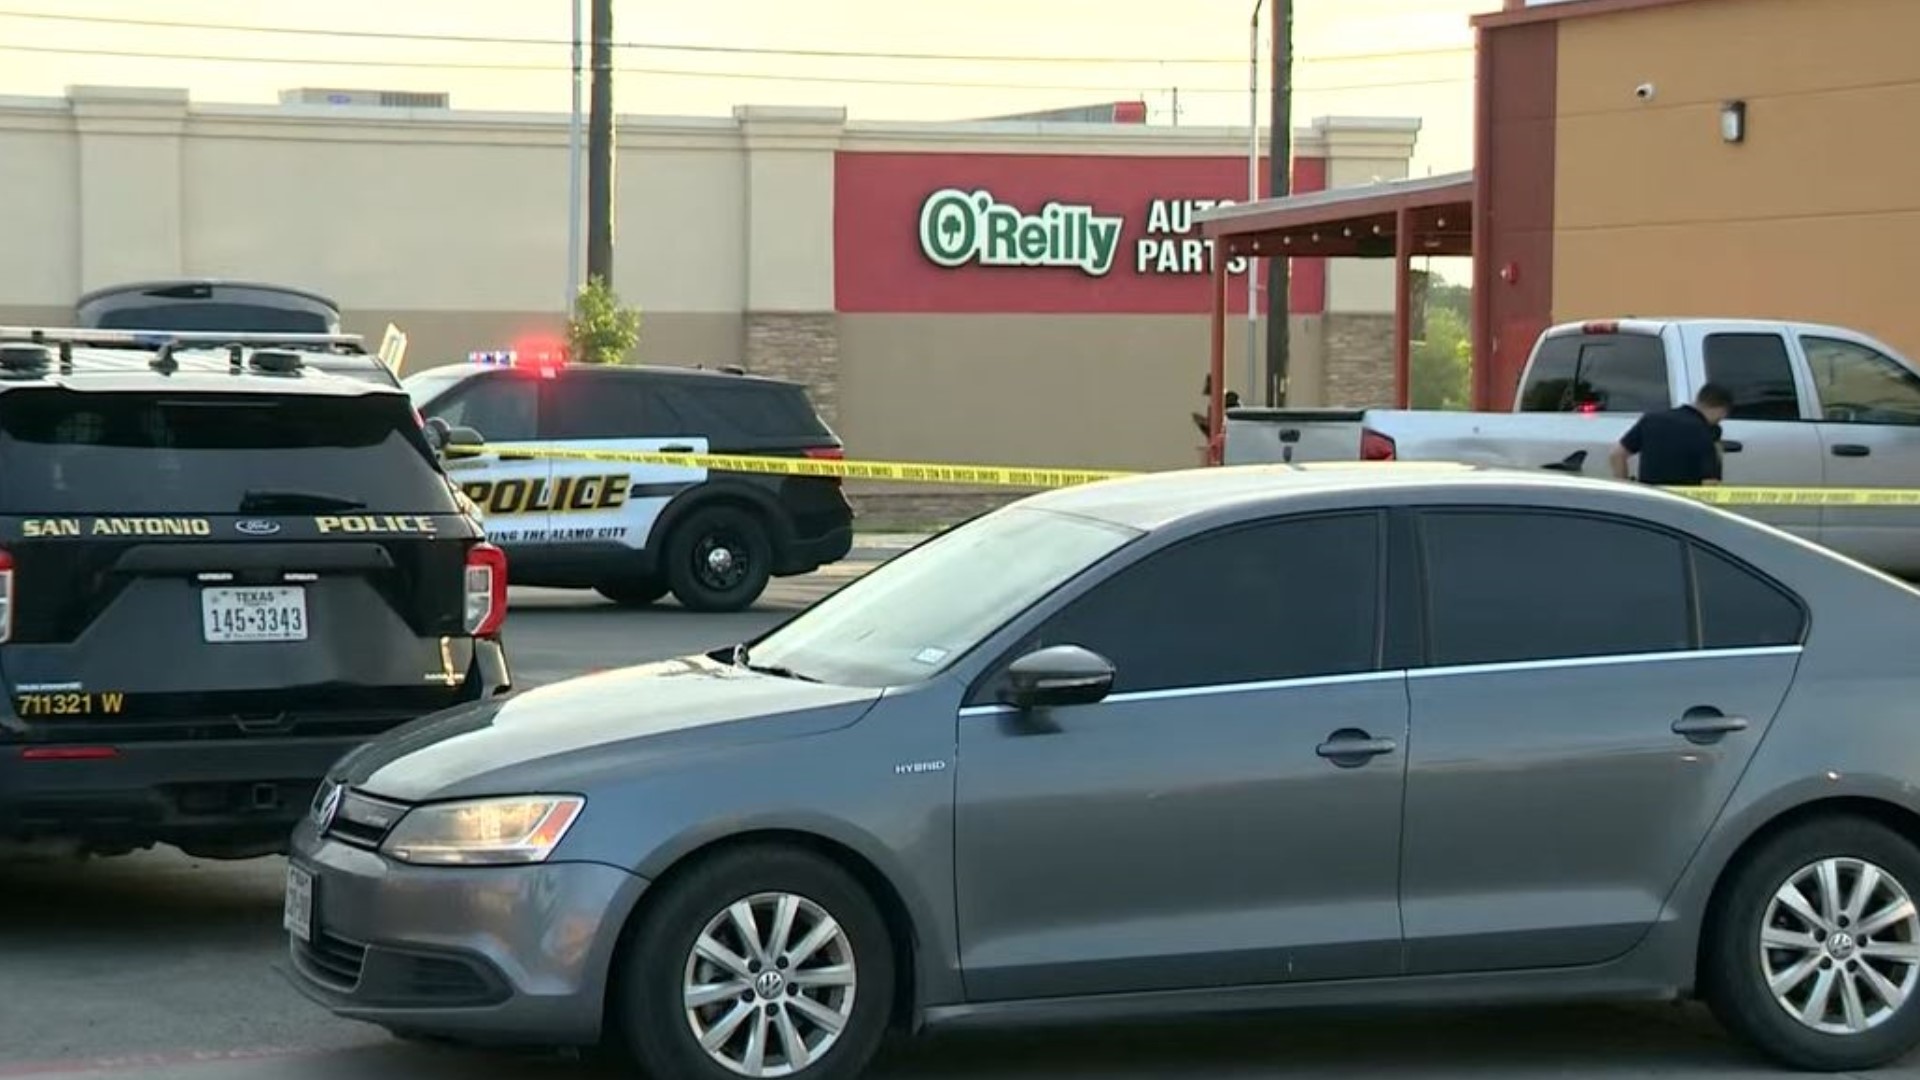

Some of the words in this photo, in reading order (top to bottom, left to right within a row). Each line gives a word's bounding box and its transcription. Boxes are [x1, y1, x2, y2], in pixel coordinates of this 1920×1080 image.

[1146, 200, 1237, 234] AU
[920, 188, 1124, 276] O'Reilly
[462, 473, 631, 515] POLICE
[22, 519, 81, 537] SAN
[92, 518, 211, 536] ANTONIO
[315, 516, 438, 534] POLICE
[522, 530, 546, 541] THE
[550, 528, 594, 540] ALAMO
[598, 527, 628, 538] CITY
[235, 591, 275, 603] TEXAS
[18, 694, 92, 715] 711321
[102, 693, 124, 714] W
[895, 760, 946, 774] HYBRID
